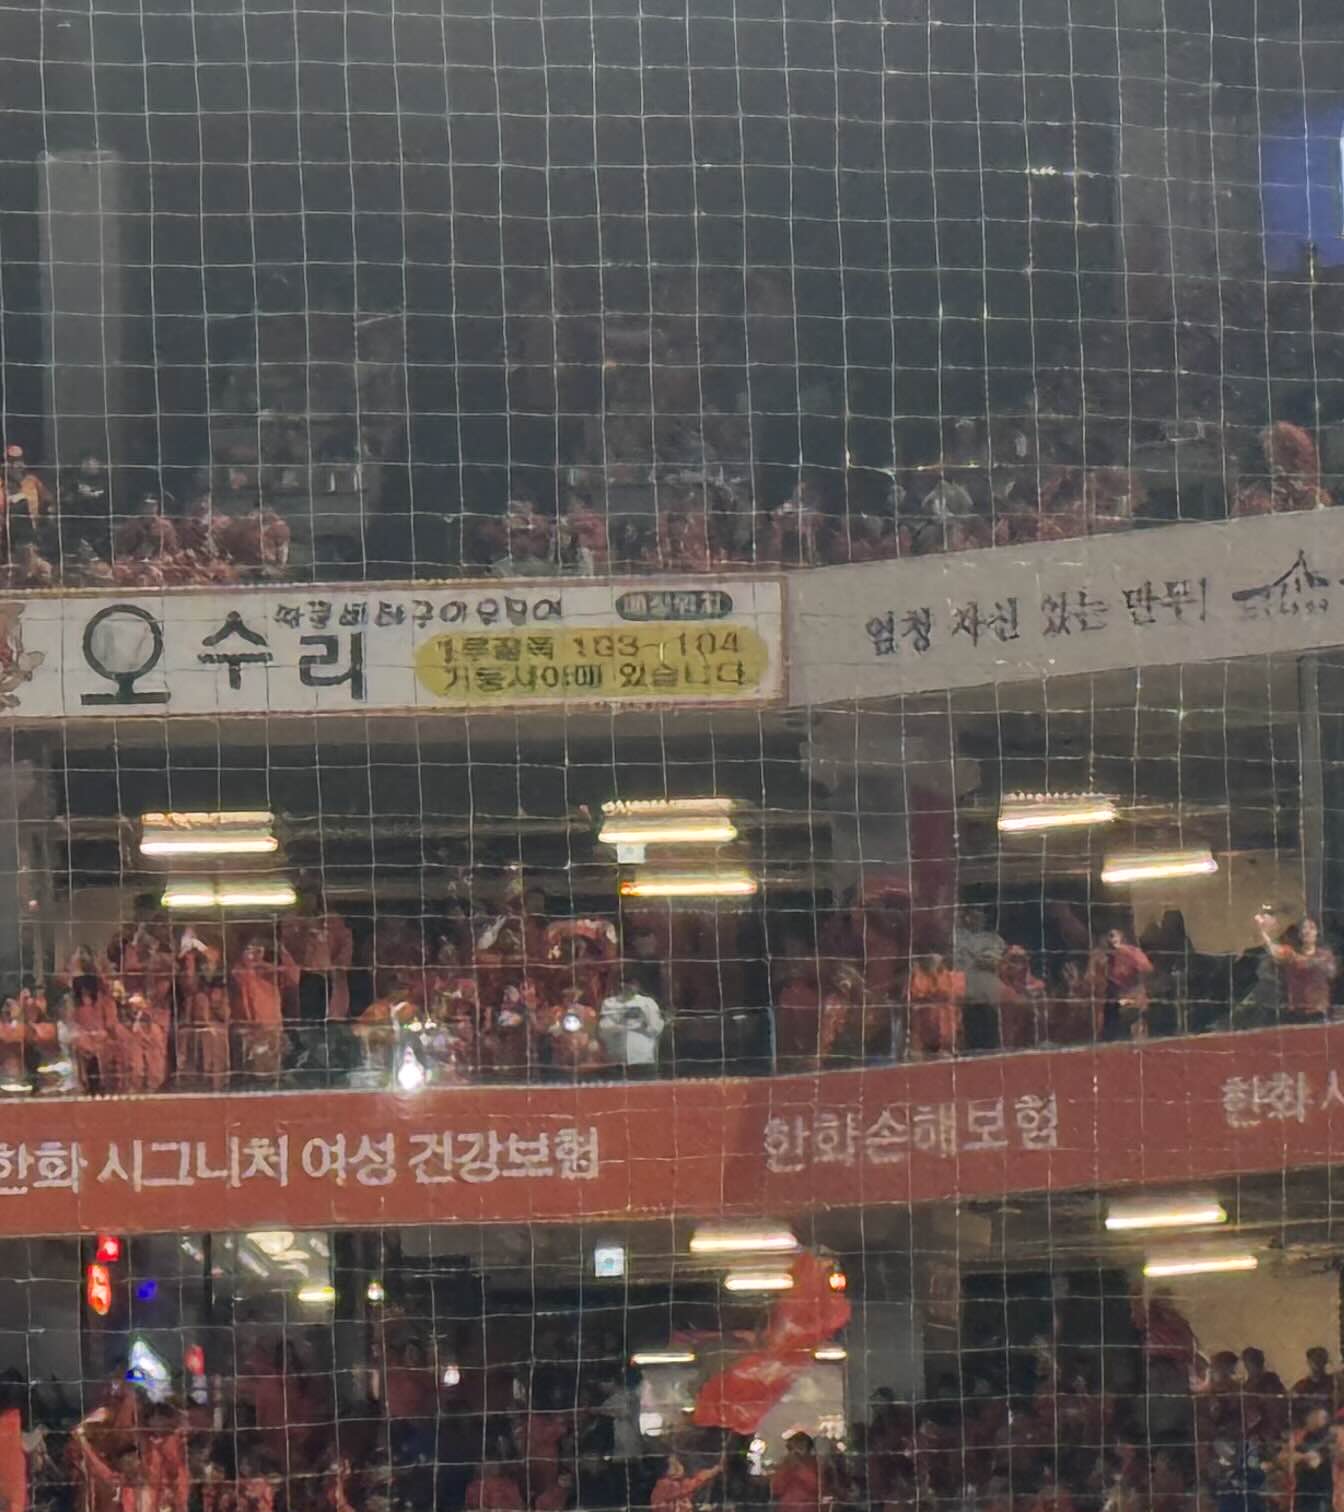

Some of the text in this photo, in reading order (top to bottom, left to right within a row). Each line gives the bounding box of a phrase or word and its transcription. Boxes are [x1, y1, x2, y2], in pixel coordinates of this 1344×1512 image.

[79, 603, 368, 705] 오수리
[763, 1094, 1060, 1174] 한화손해보험
[1221, 1070, 1307, 1130] 한화
[97, 1135, 289, 1193] 시그니처
[302, 1133, 397, 1187] 여성
[410, 1127, 600, 1182] 건강보험
